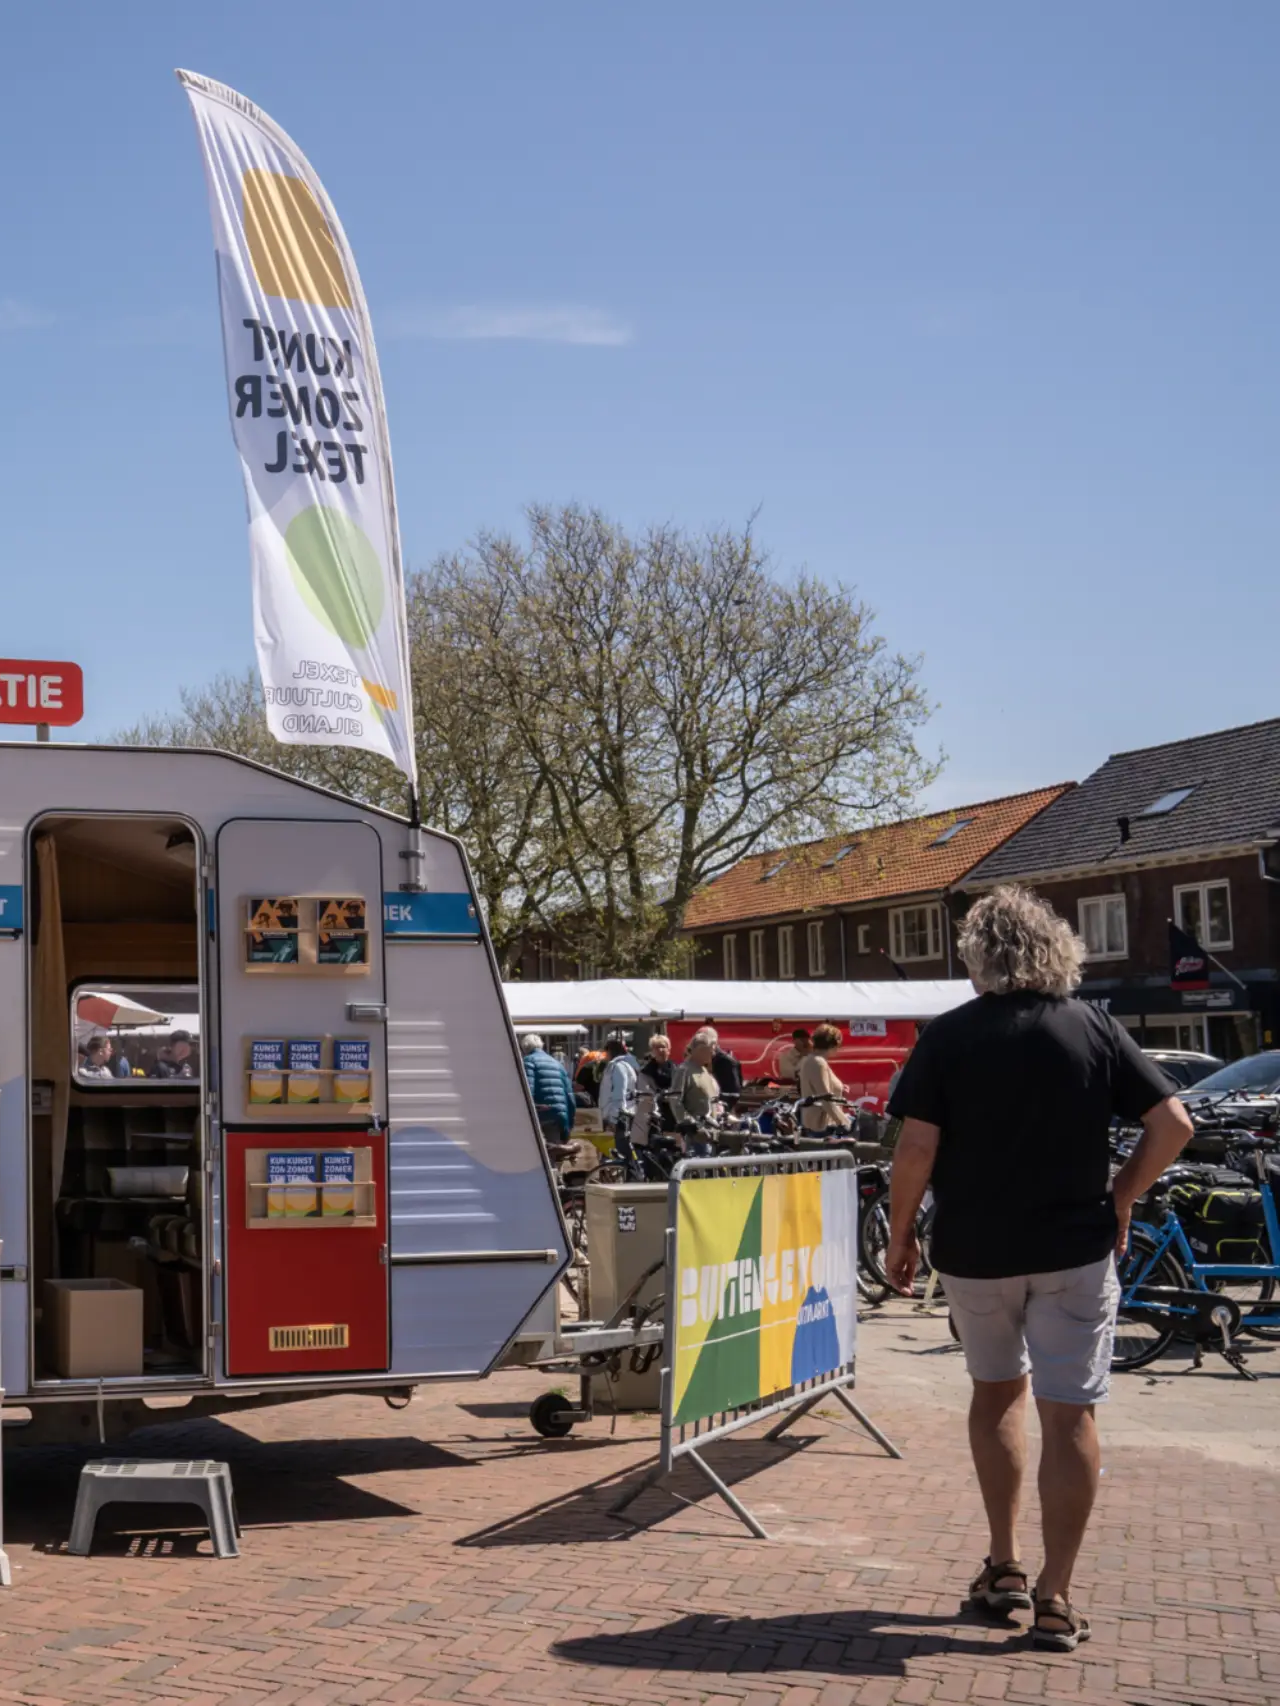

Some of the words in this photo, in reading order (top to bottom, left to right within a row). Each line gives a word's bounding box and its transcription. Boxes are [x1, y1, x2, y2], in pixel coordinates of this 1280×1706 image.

[253, 1043, 280, 1052] KUNST
[291, 1043, 317, 1052] KUNST
[340, 1043, 366, 1052] KUNST
[253, 1053, 282, 1061] ZOMER
[291, 1053, 319, 1061] ZOMER
[340, 1053, 368, 1061] ZOMER
[287, 1156, 313, 1165] KUNST
[324, 1156, 350, 1165] KUNST
[287, 1165, 315, 1173] ZOMER
[324, 1165, 352, 1173] ZOMER
